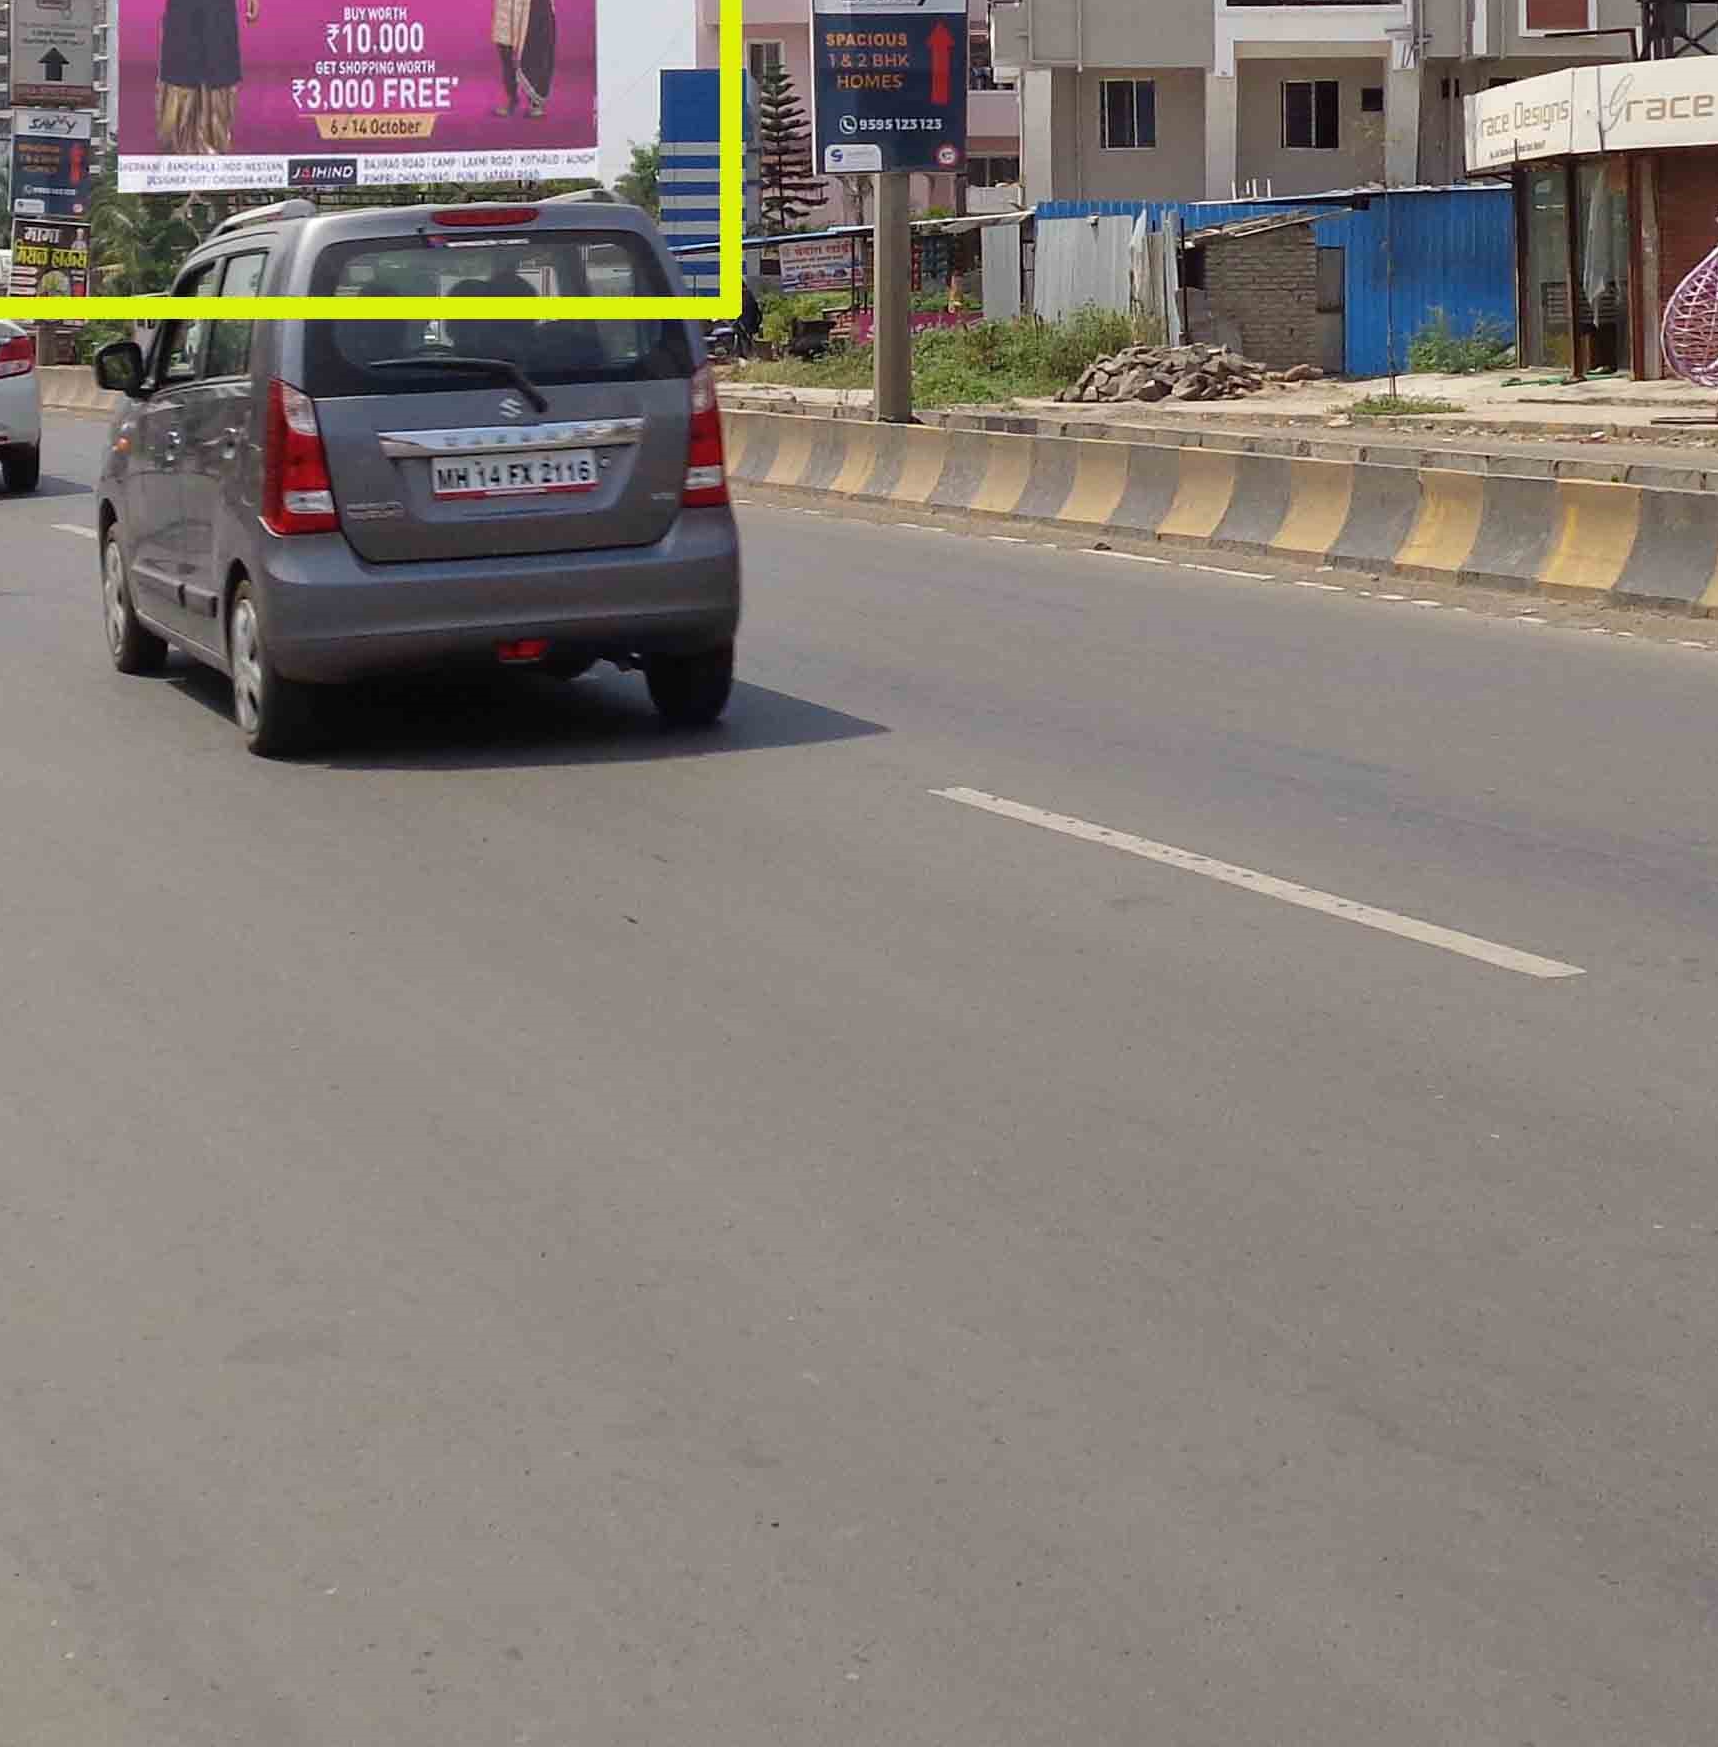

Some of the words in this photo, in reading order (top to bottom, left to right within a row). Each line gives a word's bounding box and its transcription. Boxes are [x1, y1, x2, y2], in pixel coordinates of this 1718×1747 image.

[343, 7, 366, 21] BUY
[368, 6, 407, 21] WORTH
[825, 32, 908, 47] SPACIOUS
[315, 61, 337, 75] GET
[339, 60, 395, 74] SHOPPING
[396, 60, 435, 74] WORTH
[842, 54, 852, 68] &
[858, 54, 869, 68] 2
[872, 53, 910, 68] BHK
[836, 74, 904, 90] HOMES
[292, 78, 375, 111] ₹3,000
[1514, 99, 1570, 132] Designs
[330, 120, 338, 135] 6
[353, 121, 367, 134] 14
[370, 119, 422, 135] October
[859, 118, 893, 131] 9595
[291, 165, 355, 181] JAIHIND
[437, 466, 470, 490] MH
[476, 463, 502, 487] 14
[507, 462, 533, 486] FX
[540, 459, 591, 484] 2116
